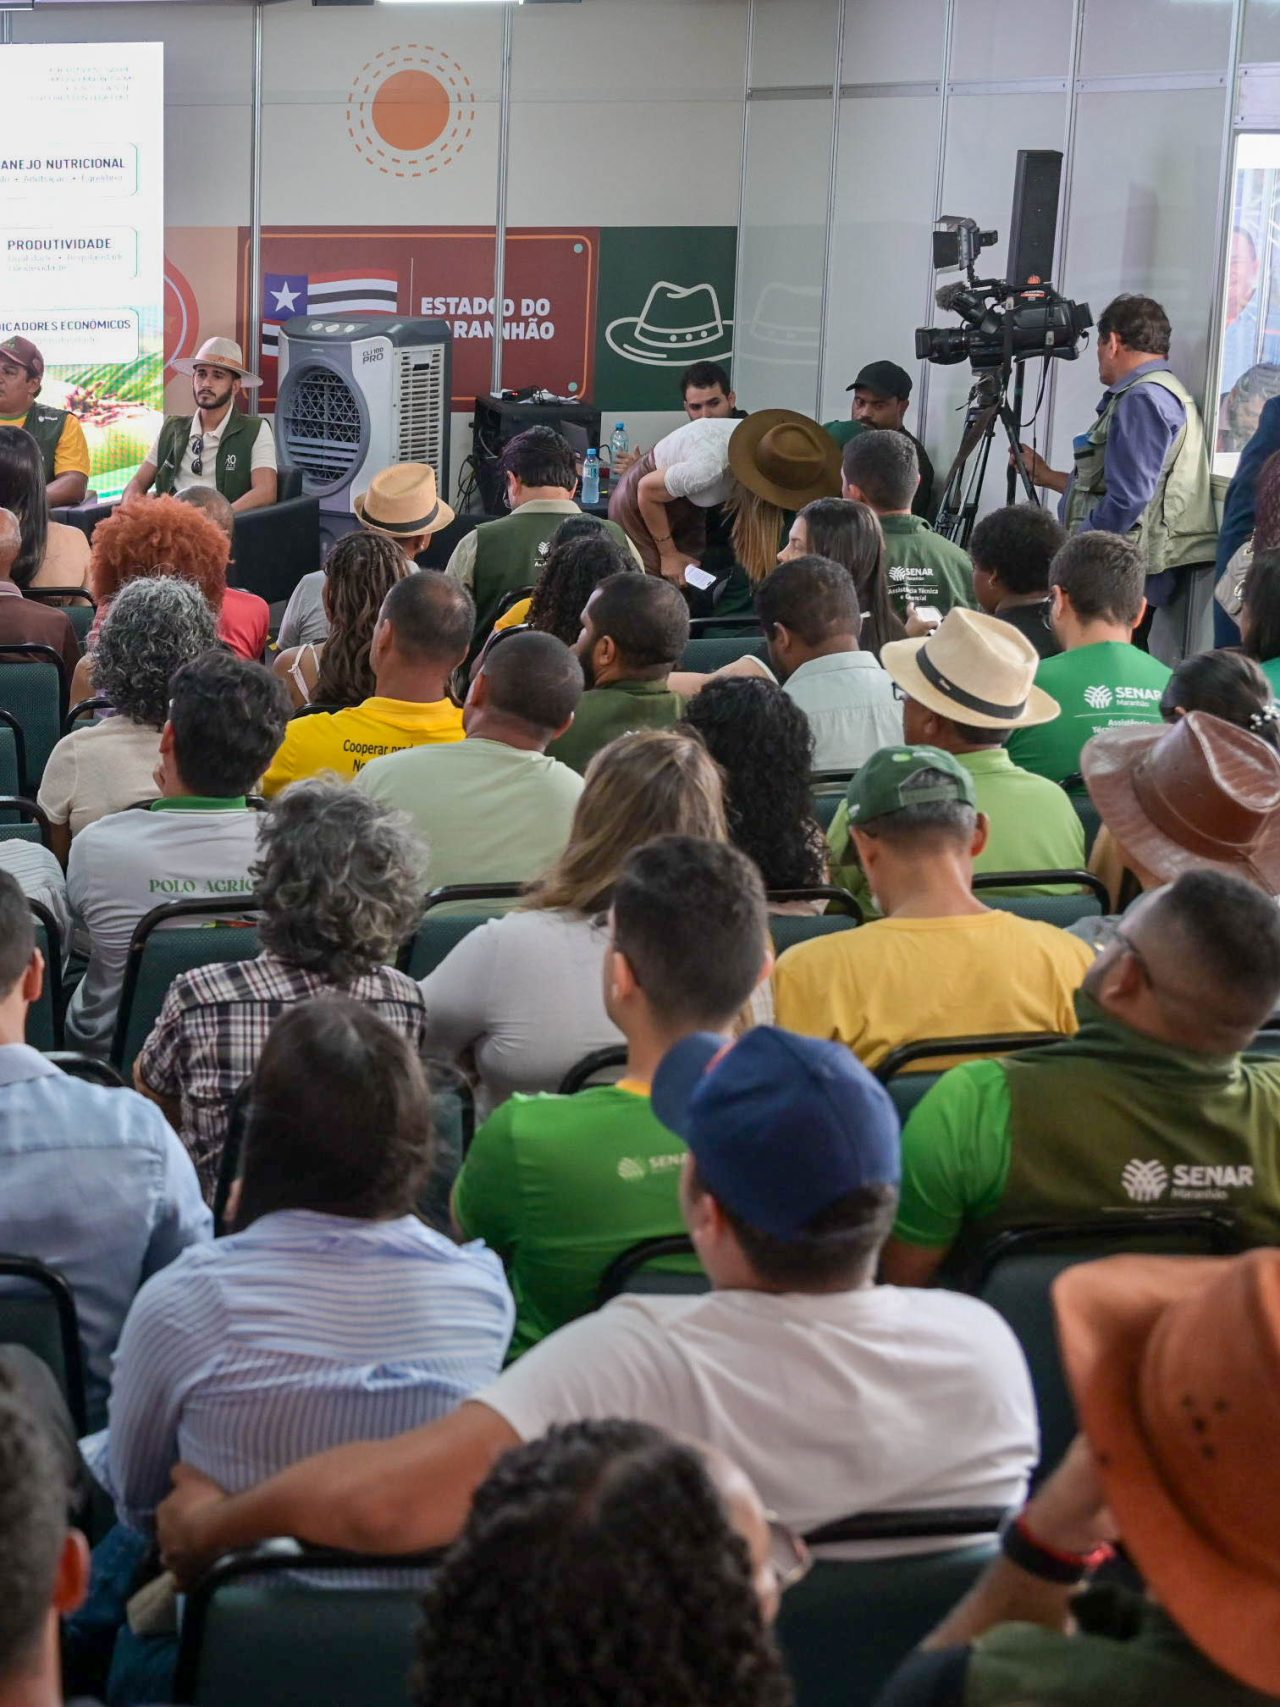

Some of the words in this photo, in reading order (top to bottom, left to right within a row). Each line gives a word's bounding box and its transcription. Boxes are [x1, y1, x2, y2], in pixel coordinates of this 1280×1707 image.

[46, 158, 125, 170] NUTRICIONAL
[7, 238, 112, 251] PRODUTIVIDADE
[521, 298, 551, 317] DO
[905, 567, 934, 576] SENAR
[343, 738, 388, 757] Cooperar
[149, 879, 196, 893] POLO
[1172, 1164, 1254, 1187] SENAR
